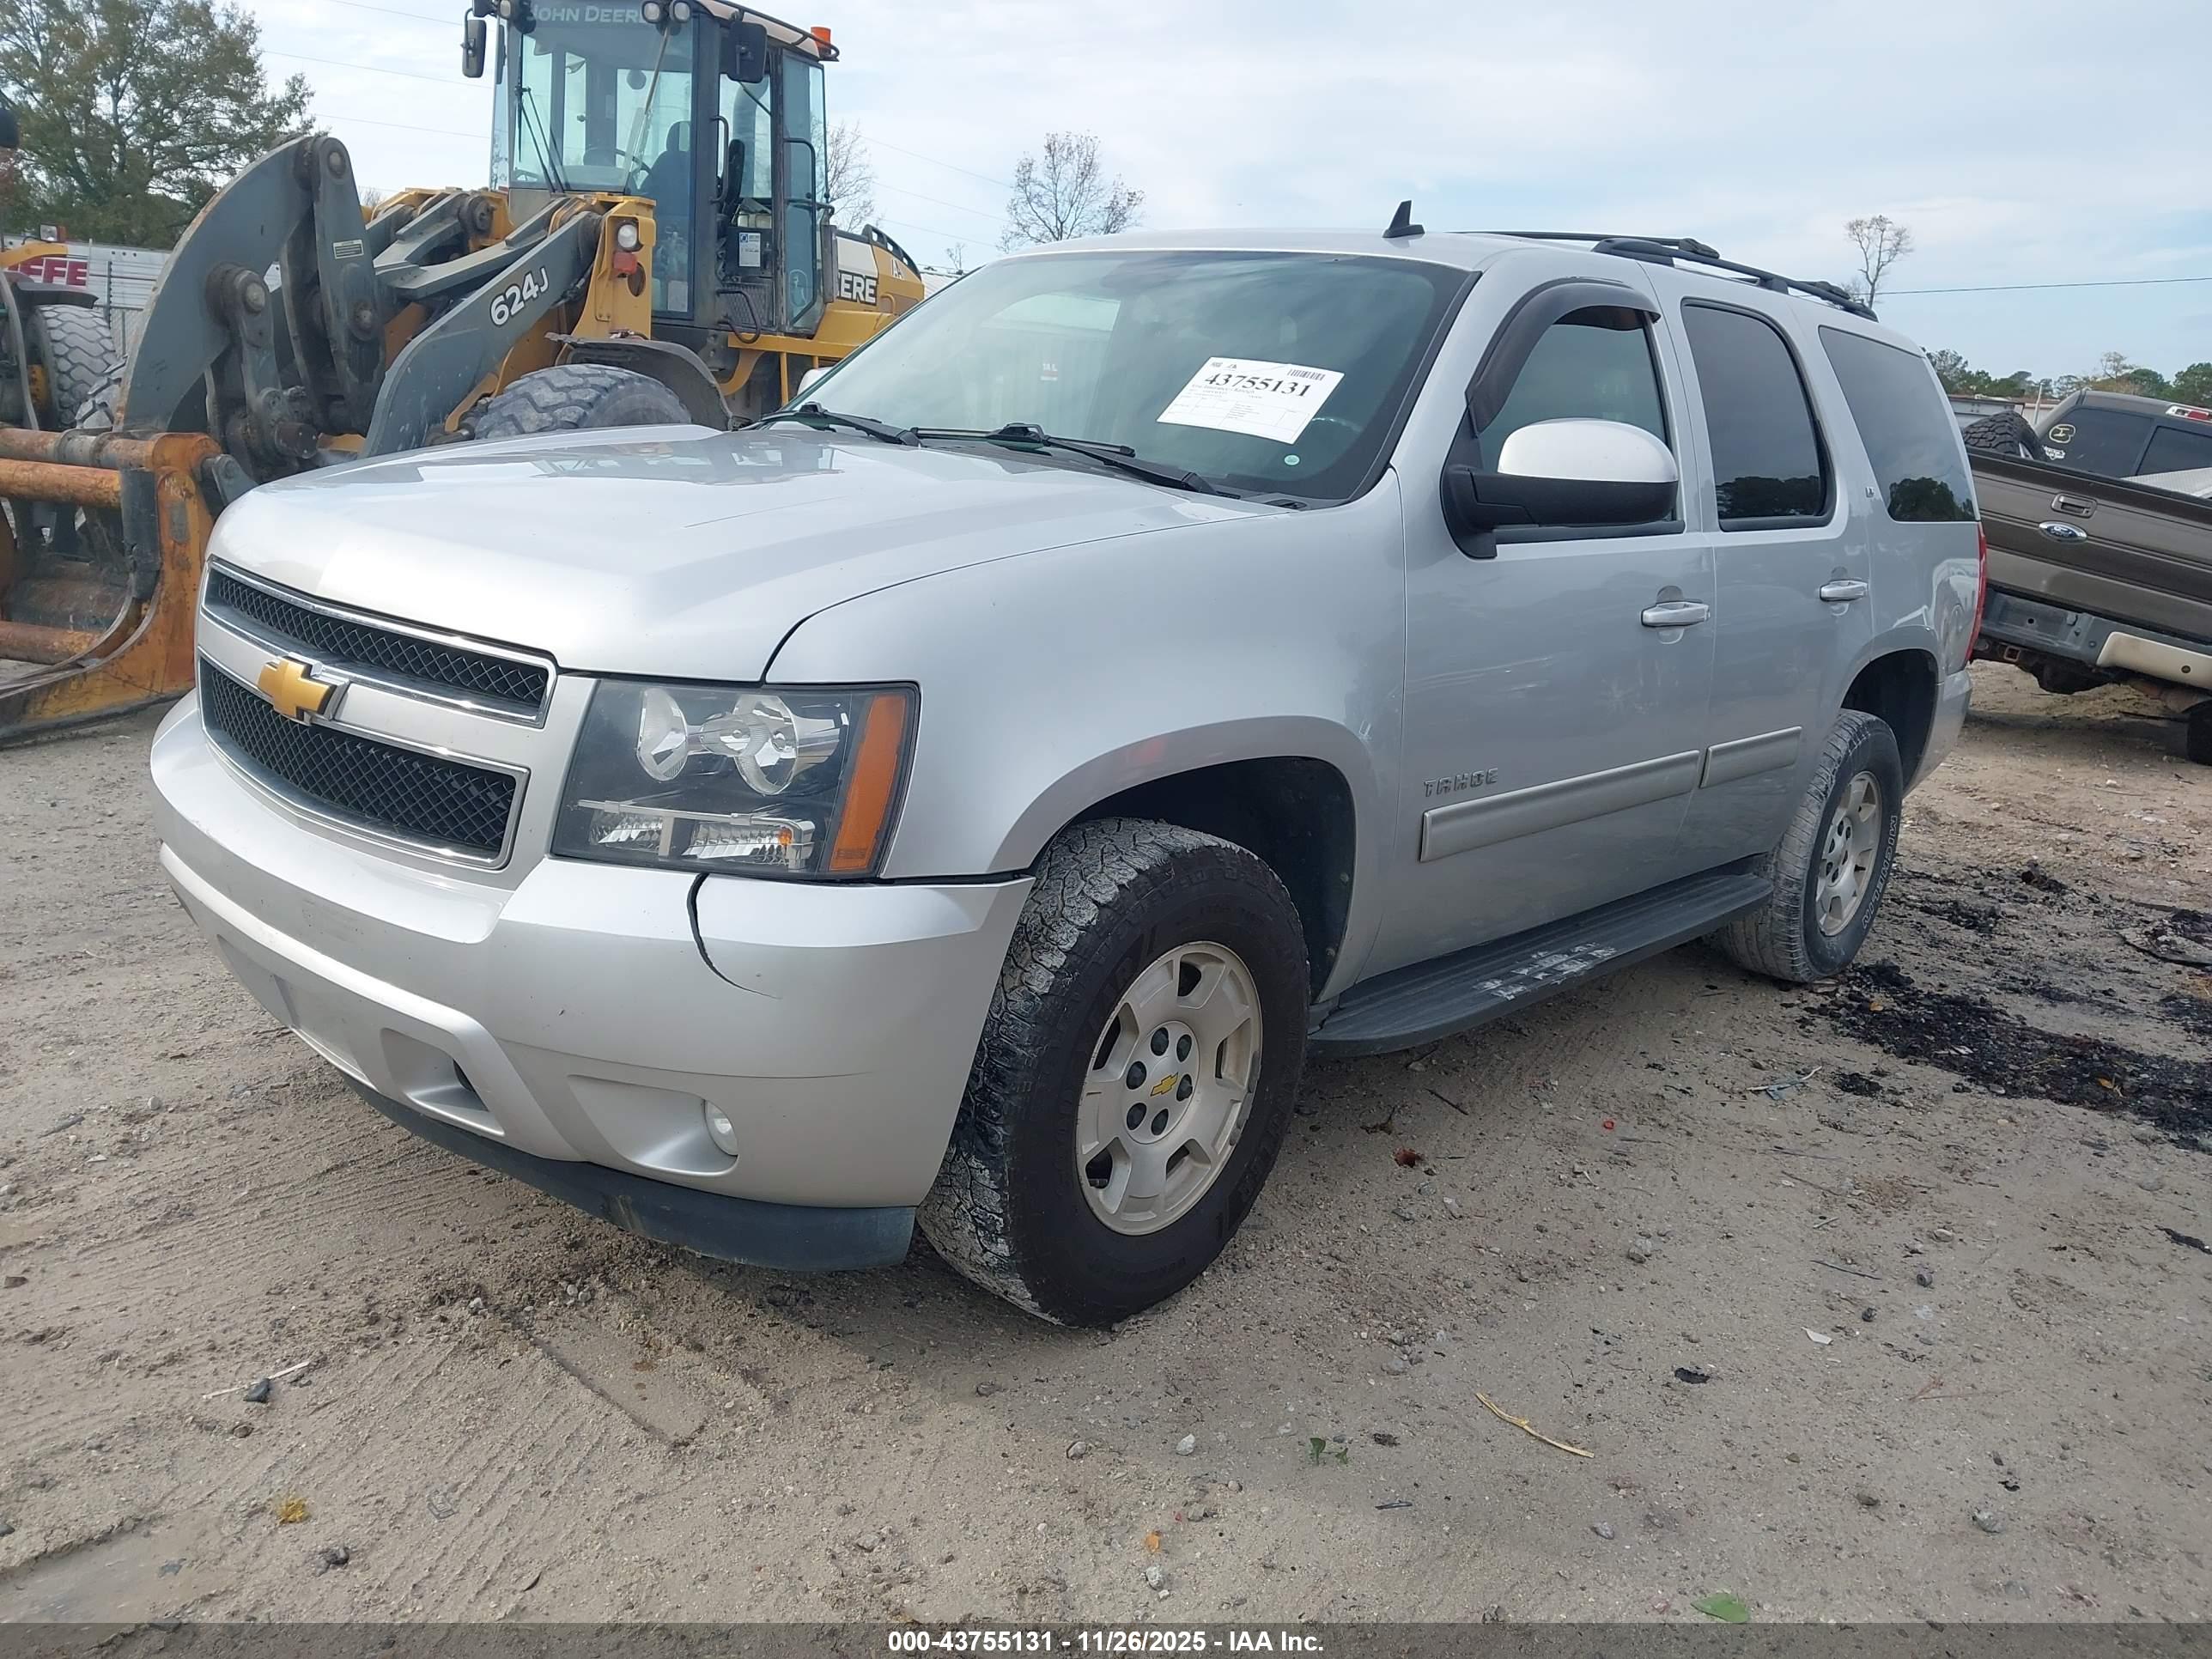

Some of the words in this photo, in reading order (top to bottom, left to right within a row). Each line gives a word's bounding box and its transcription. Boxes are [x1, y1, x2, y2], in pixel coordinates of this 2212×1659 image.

[527, 4, 580, 21] JOHN
[490, 267, 549, 325] 624J
[838, 270, 877, 305] ERE
[1204, 372, 1312, 397] 43755131
[1424, 768, 1498, 798] TAHOE
